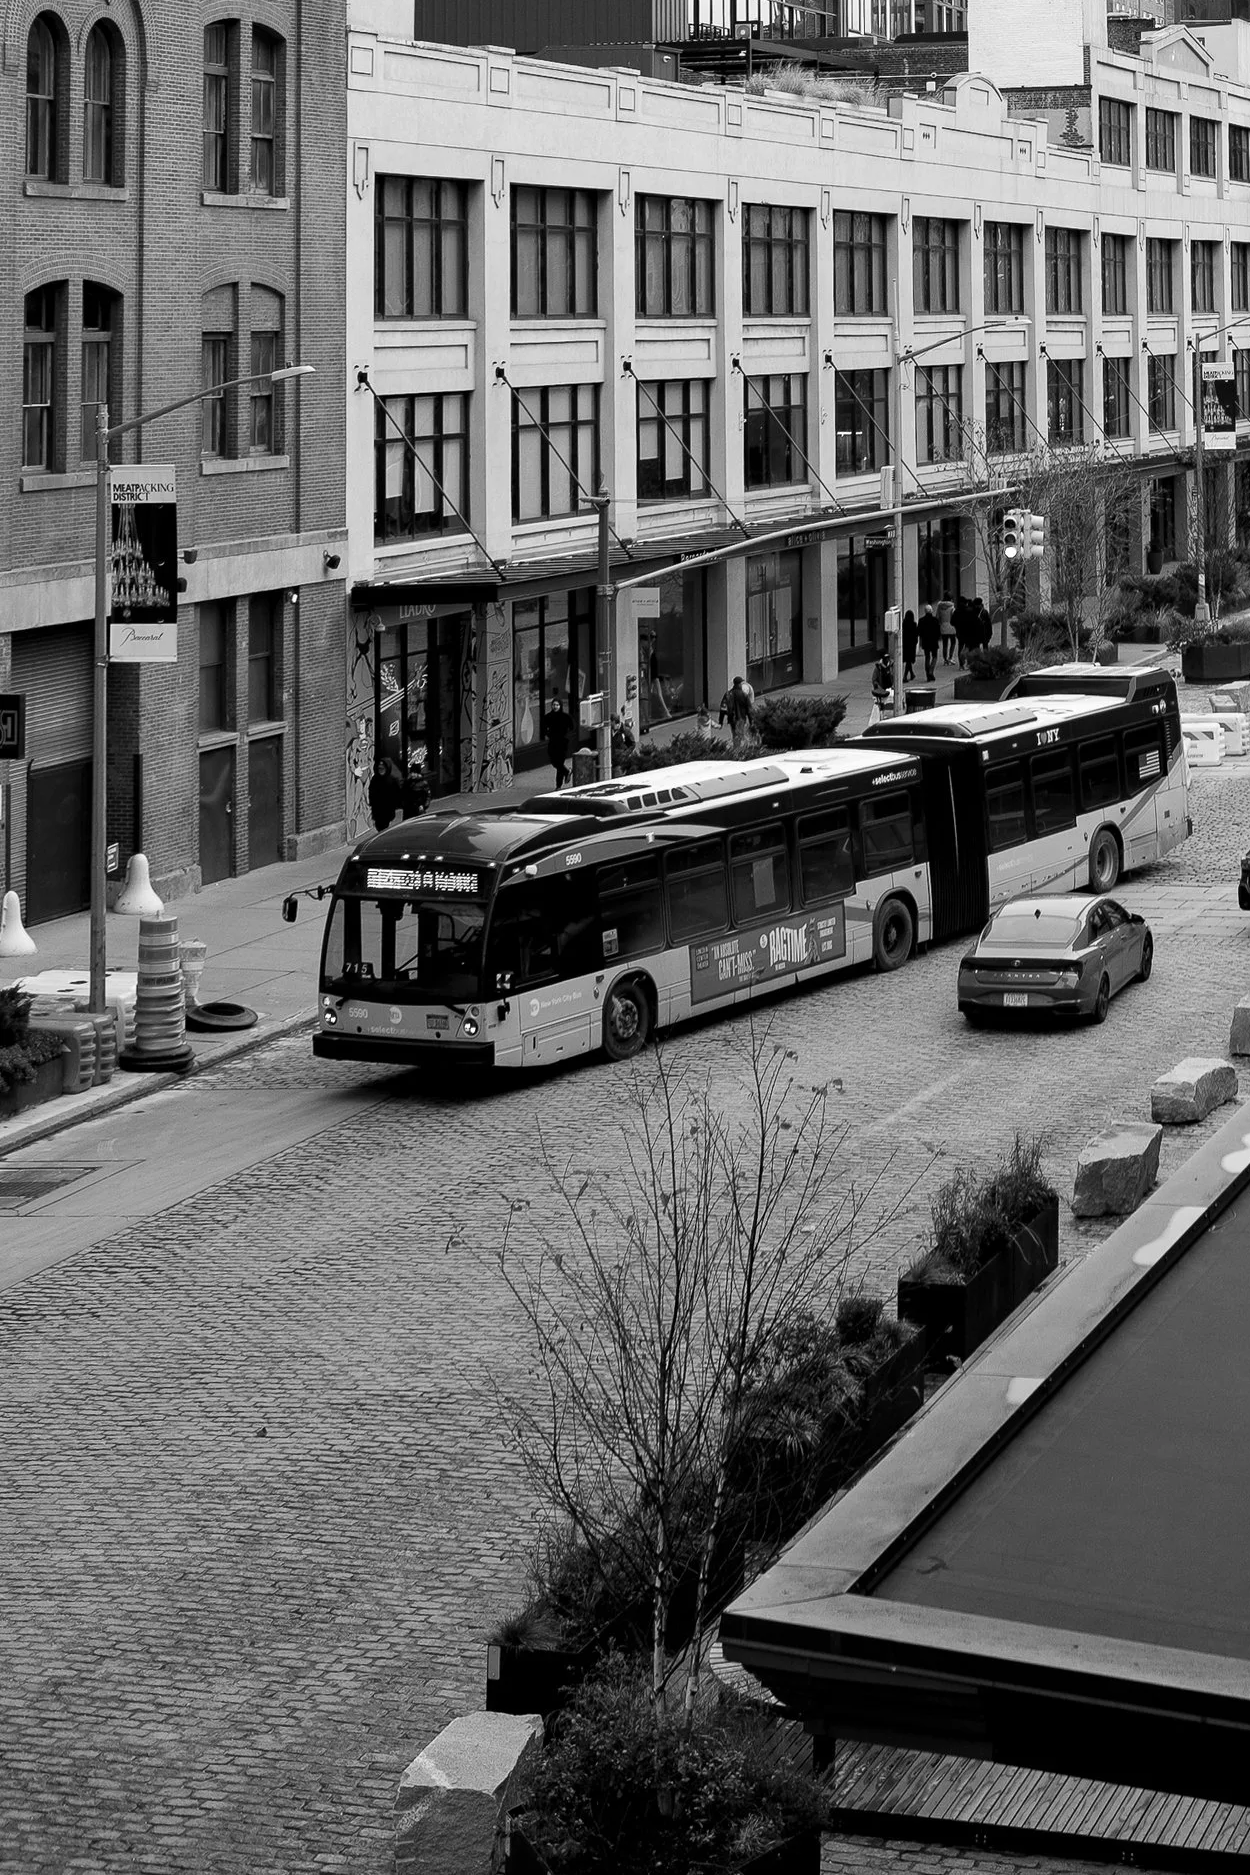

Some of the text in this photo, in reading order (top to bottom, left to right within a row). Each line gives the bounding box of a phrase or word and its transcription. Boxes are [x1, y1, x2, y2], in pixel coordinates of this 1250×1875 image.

[113, 483, 174, 492] MEATPACKING
[113, 492, 150, 501] DISTRICT
[1047, 728, 1060, 743] NY
[566, 853, 581, 865] 5590
[769, 923, 807, 967] RAGTIME
[349, 1007, 368, 1019] 5590
